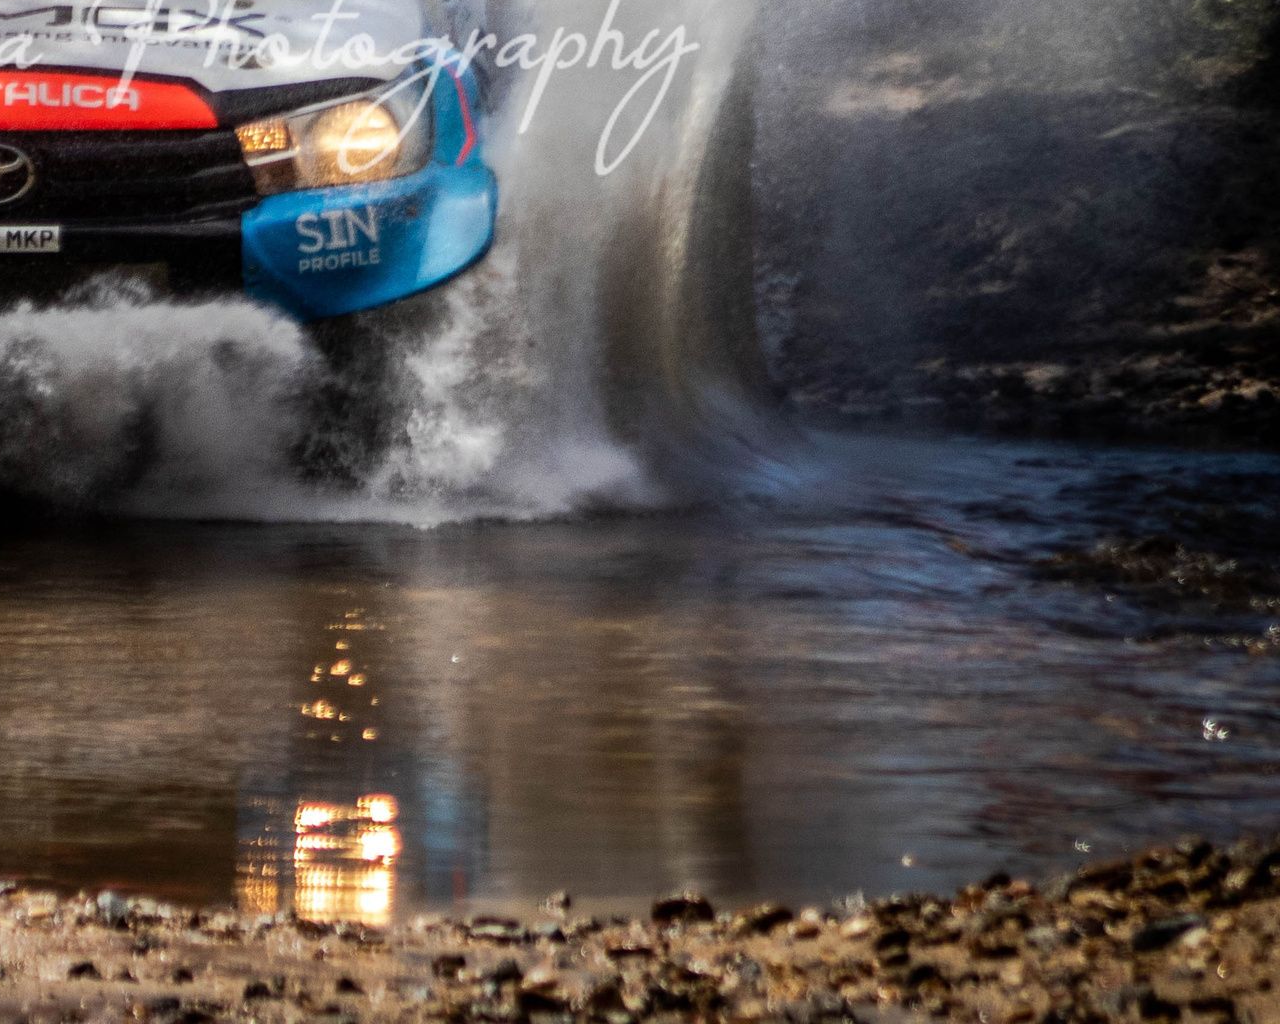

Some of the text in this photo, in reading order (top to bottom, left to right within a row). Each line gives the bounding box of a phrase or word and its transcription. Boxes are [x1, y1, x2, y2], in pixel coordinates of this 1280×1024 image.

[6, 230, 54, 249] MKP
[295, 205, 380, 254] SIN
[298, 248, 381, 275] PROFILE
